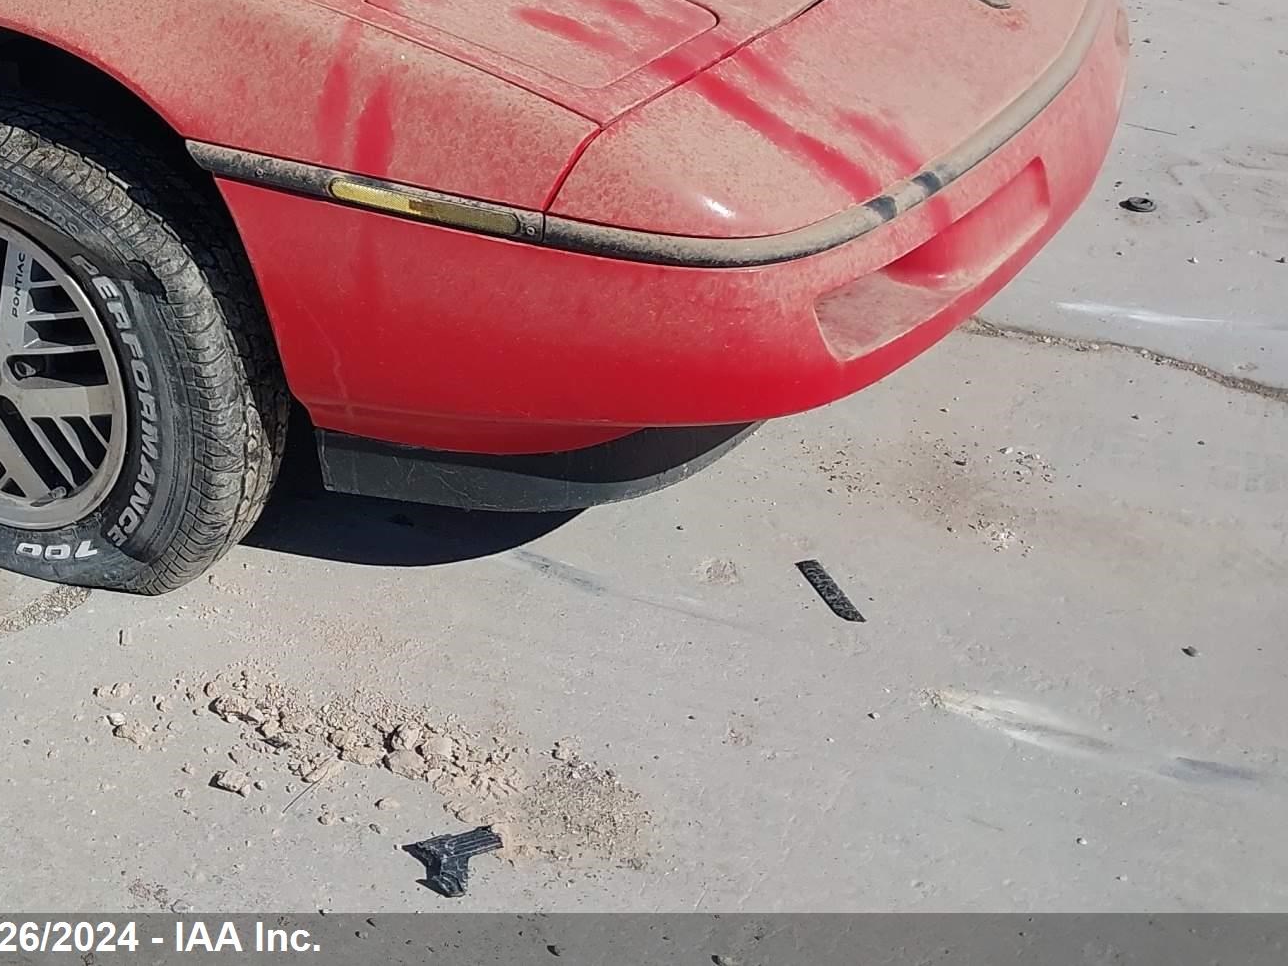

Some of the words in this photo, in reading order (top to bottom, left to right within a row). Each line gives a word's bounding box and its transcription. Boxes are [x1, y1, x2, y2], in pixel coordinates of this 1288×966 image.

[12, 251, 26, 318] PONTIAC
[71, 254, 159, 547] PERFORMANCE
[15, 540, 98, 561] 700
